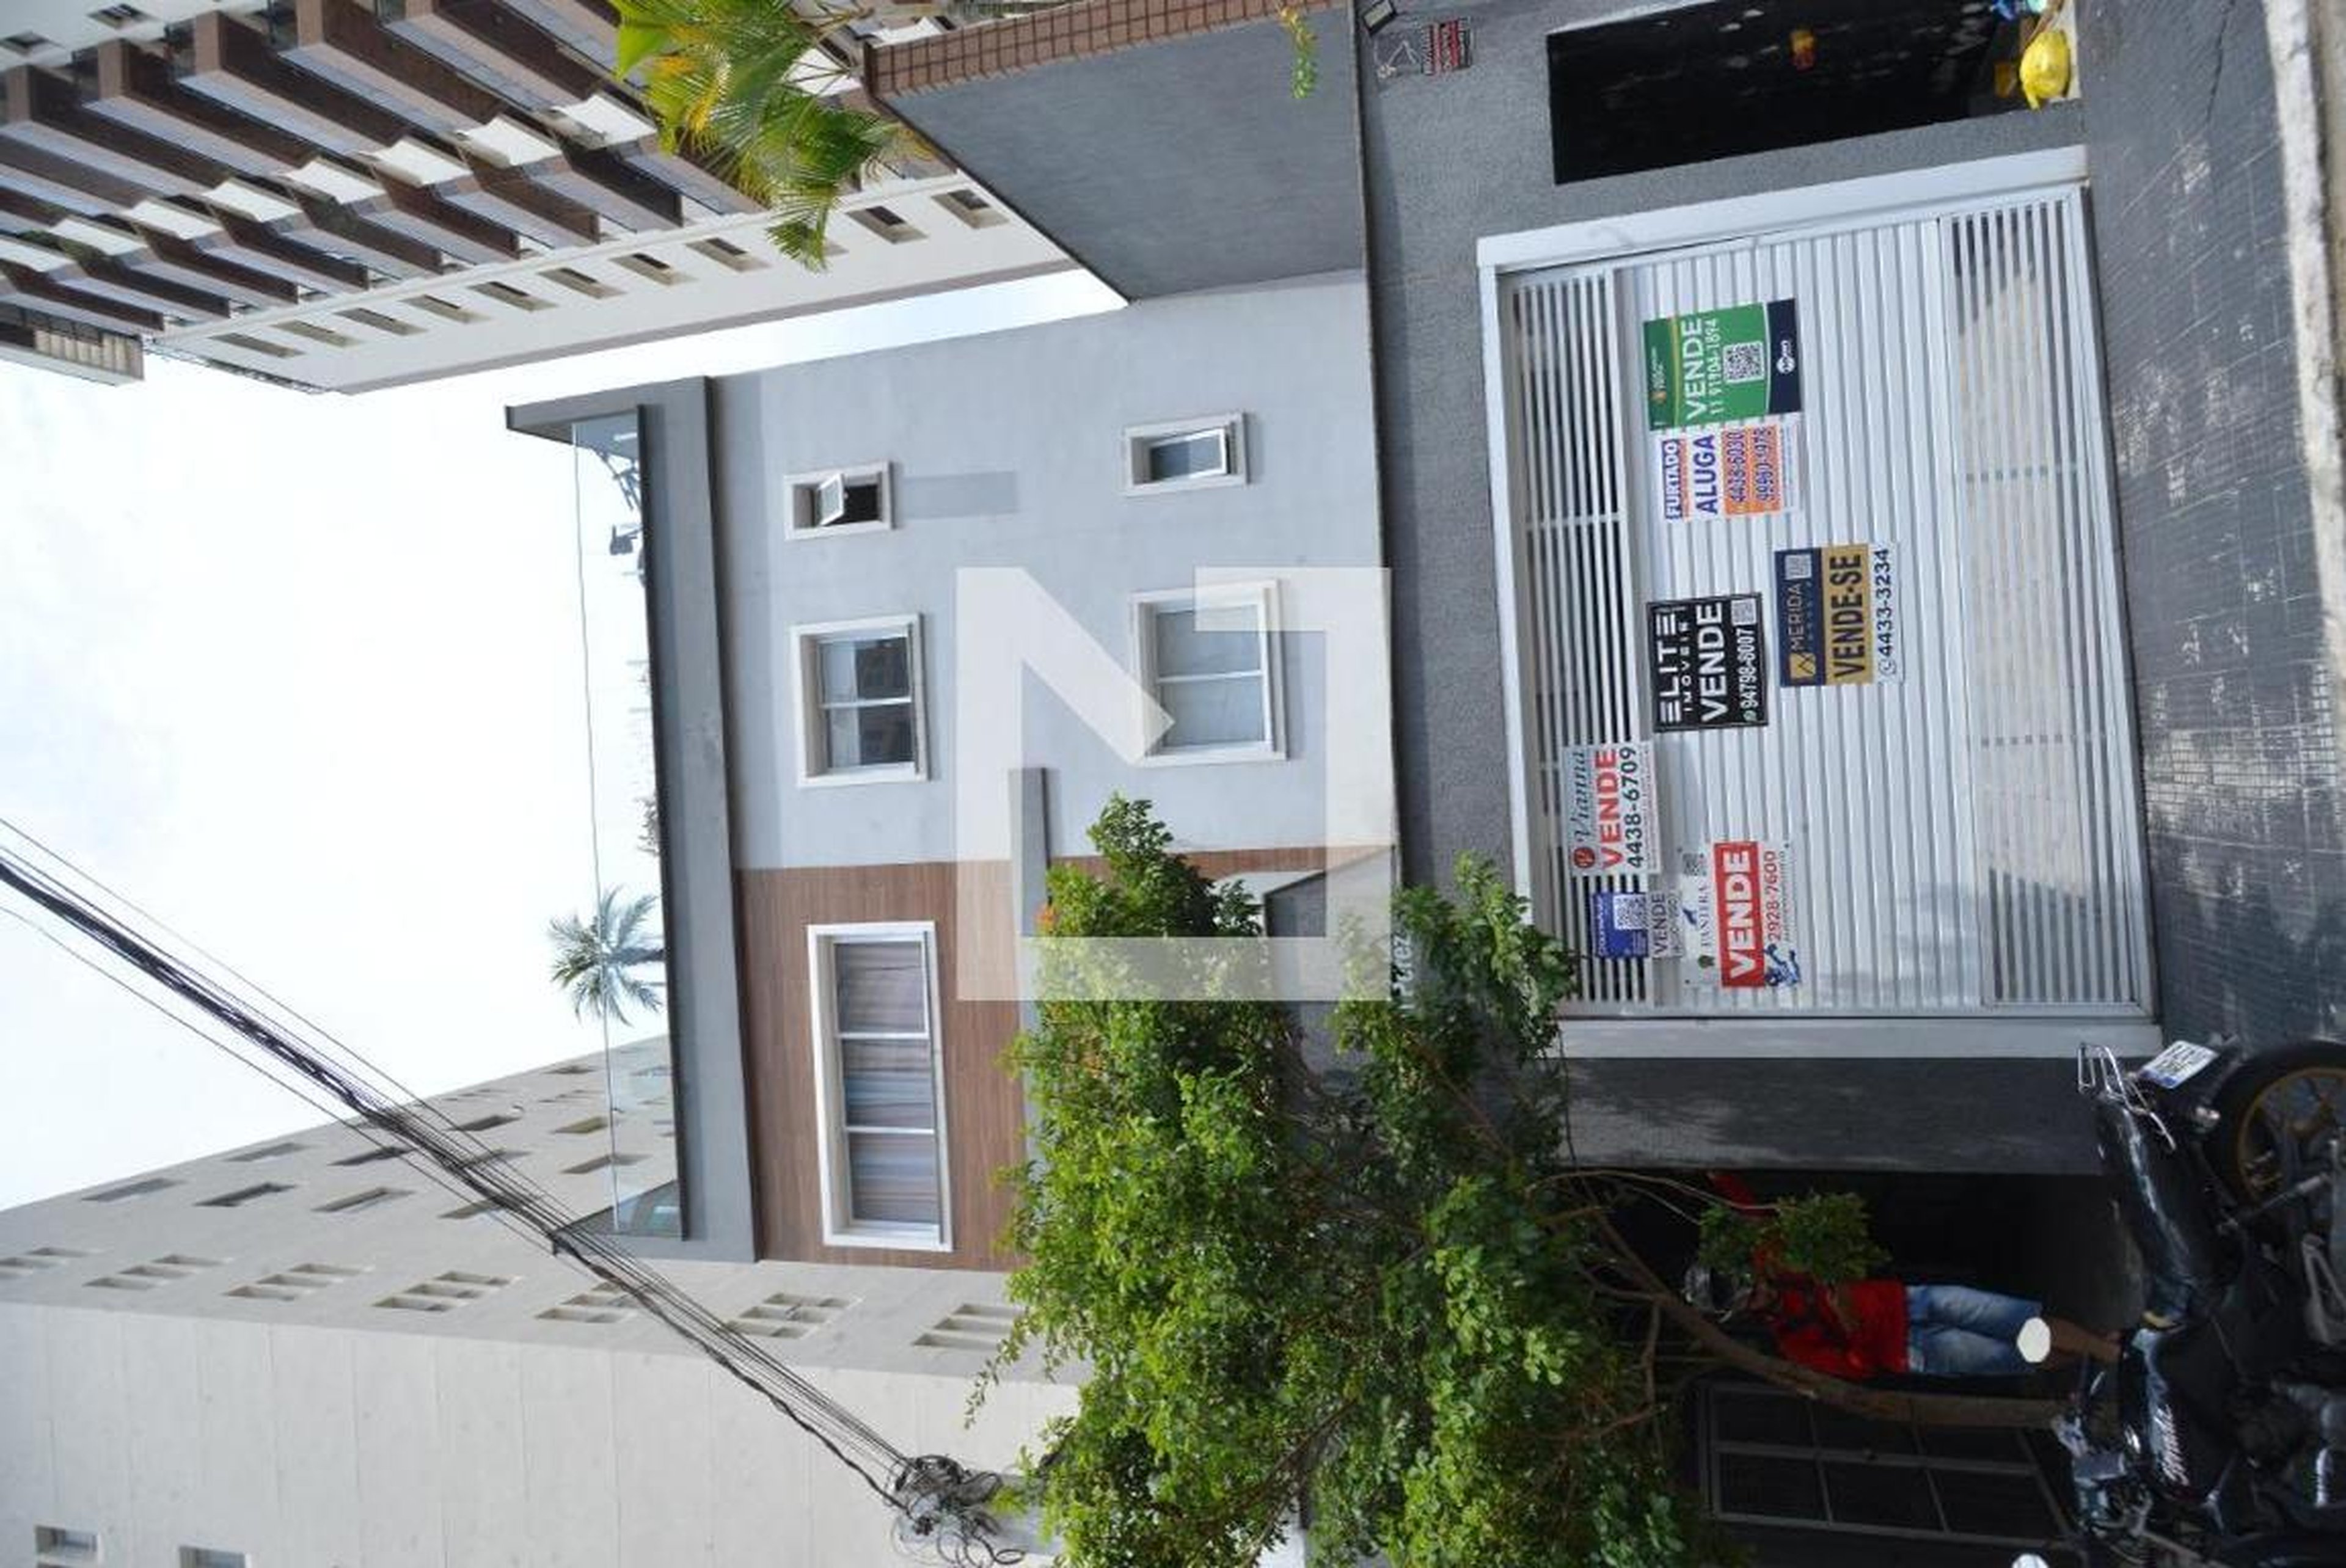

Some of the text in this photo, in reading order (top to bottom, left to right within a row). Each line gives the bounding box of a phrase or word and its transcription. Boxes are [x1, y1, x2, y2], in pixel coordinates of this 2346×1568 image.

[1680, 318, 1707, 420] VENDE
[1709, 400, 1724, 415] 11
[1664, 442, 1680, 517] FURTADO
[1692, 434, 1718, 514] ALUGA
[1787, 583, 1804, 651] MERIDA
[1829, 554, 1866, 678] VENDE-SE
[1874, 549, 1893, 657] 4433-3234
[1656, 613, 1681, 723] ELITE
[1695, 602, 1728, 722] VENDE
[1570, 752, 1591, 842] Vianna
[1595, 749, 1624, 869] VENDE
[1619, 746, 1644, 868] 4438-6709
[1651, 893, 1668, 955] VENDE
[1722, 850, 1756, 978] VENDE
[1763, 850, 1781, 941] 2928-7600
